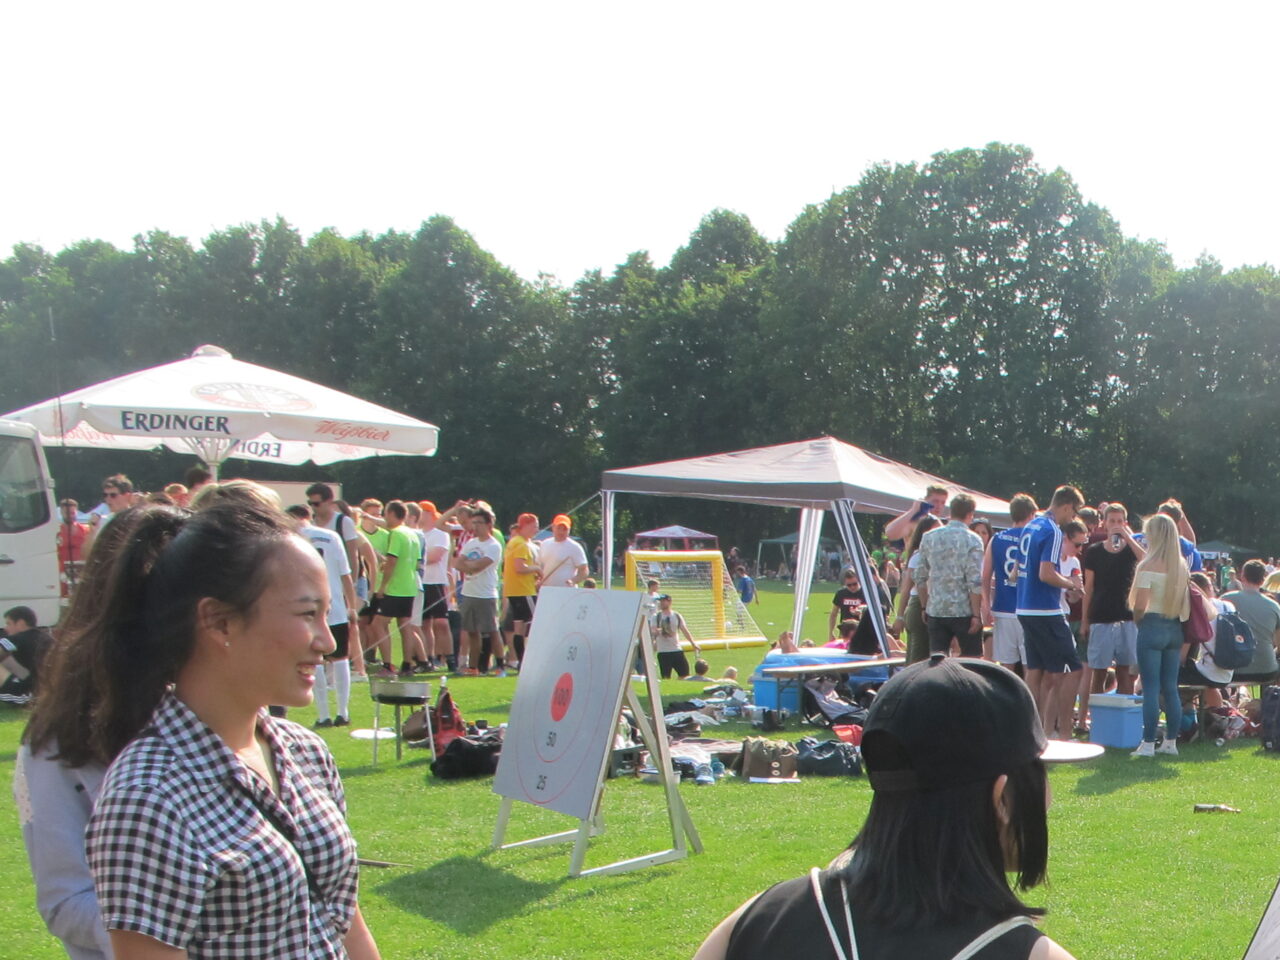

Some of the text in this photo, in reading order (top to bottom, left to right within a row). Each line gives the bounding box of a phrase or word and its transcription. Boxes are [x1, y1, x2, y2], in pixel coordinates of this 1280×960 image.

[121, 411, 231, 435] ERDINGER
[566, 646, 578, 661] 50
[554, 687, 570, 706] 100
[546, 731, 557, 747] 50
[536, 775, 548, 790] 25
